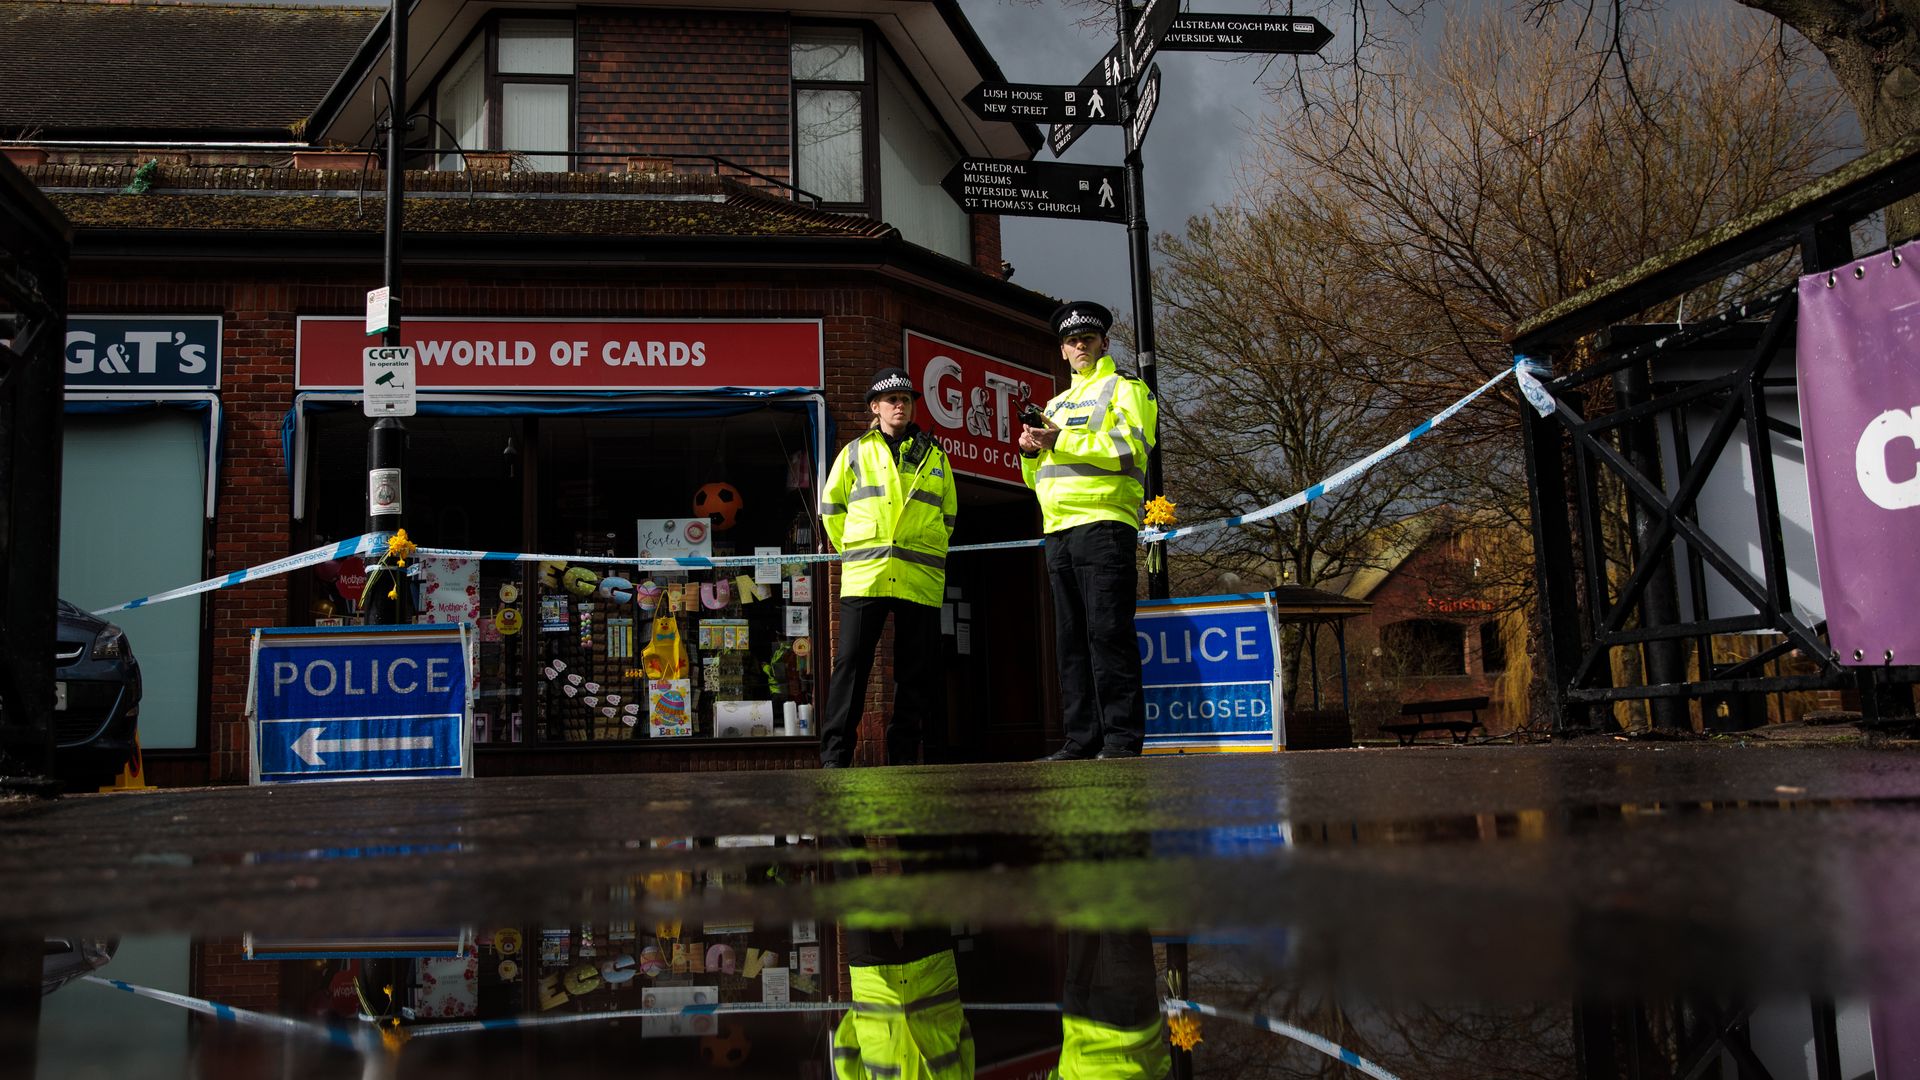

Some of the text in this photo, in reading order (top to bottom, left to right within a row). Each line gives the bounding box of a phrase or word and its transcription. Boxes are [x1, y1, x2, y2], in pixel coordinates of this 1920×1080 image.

[1227, 22, 1262, 31] COACH
[1264, 23, 1289, 31] PARK
[1164, 34, 1243, 44] RIVERSIDE WALK
[984, 89, 1008, 98] LUSH
[1012, 91, 1043, 100] HOUSE
[984, 104, 1006, 112] NEW
[1012, 106, 1048, 116] STREET
[963, 162, 1027, 174] CATHEDRAL
[964, 174, 1012, 184] MUSEUMS
[964, 186, 1048, 199] RIVERSIDE WALK
[964, 199, 1081, 213] ST. THOMAS'S CHURCH
[368, 348, 409, 360] CCTV
[416, 341, 706, 366] WORLD OF CARDS
[983, 448, 999, 464] OF
[438, 603, 468, 612] Mother's
[447, 614, 460, 623] Day
[273, 658, 450, 697] POLICE
[1169, 698, 1266, 720] CLOSED
[659, 727, 691, 736] Easter
